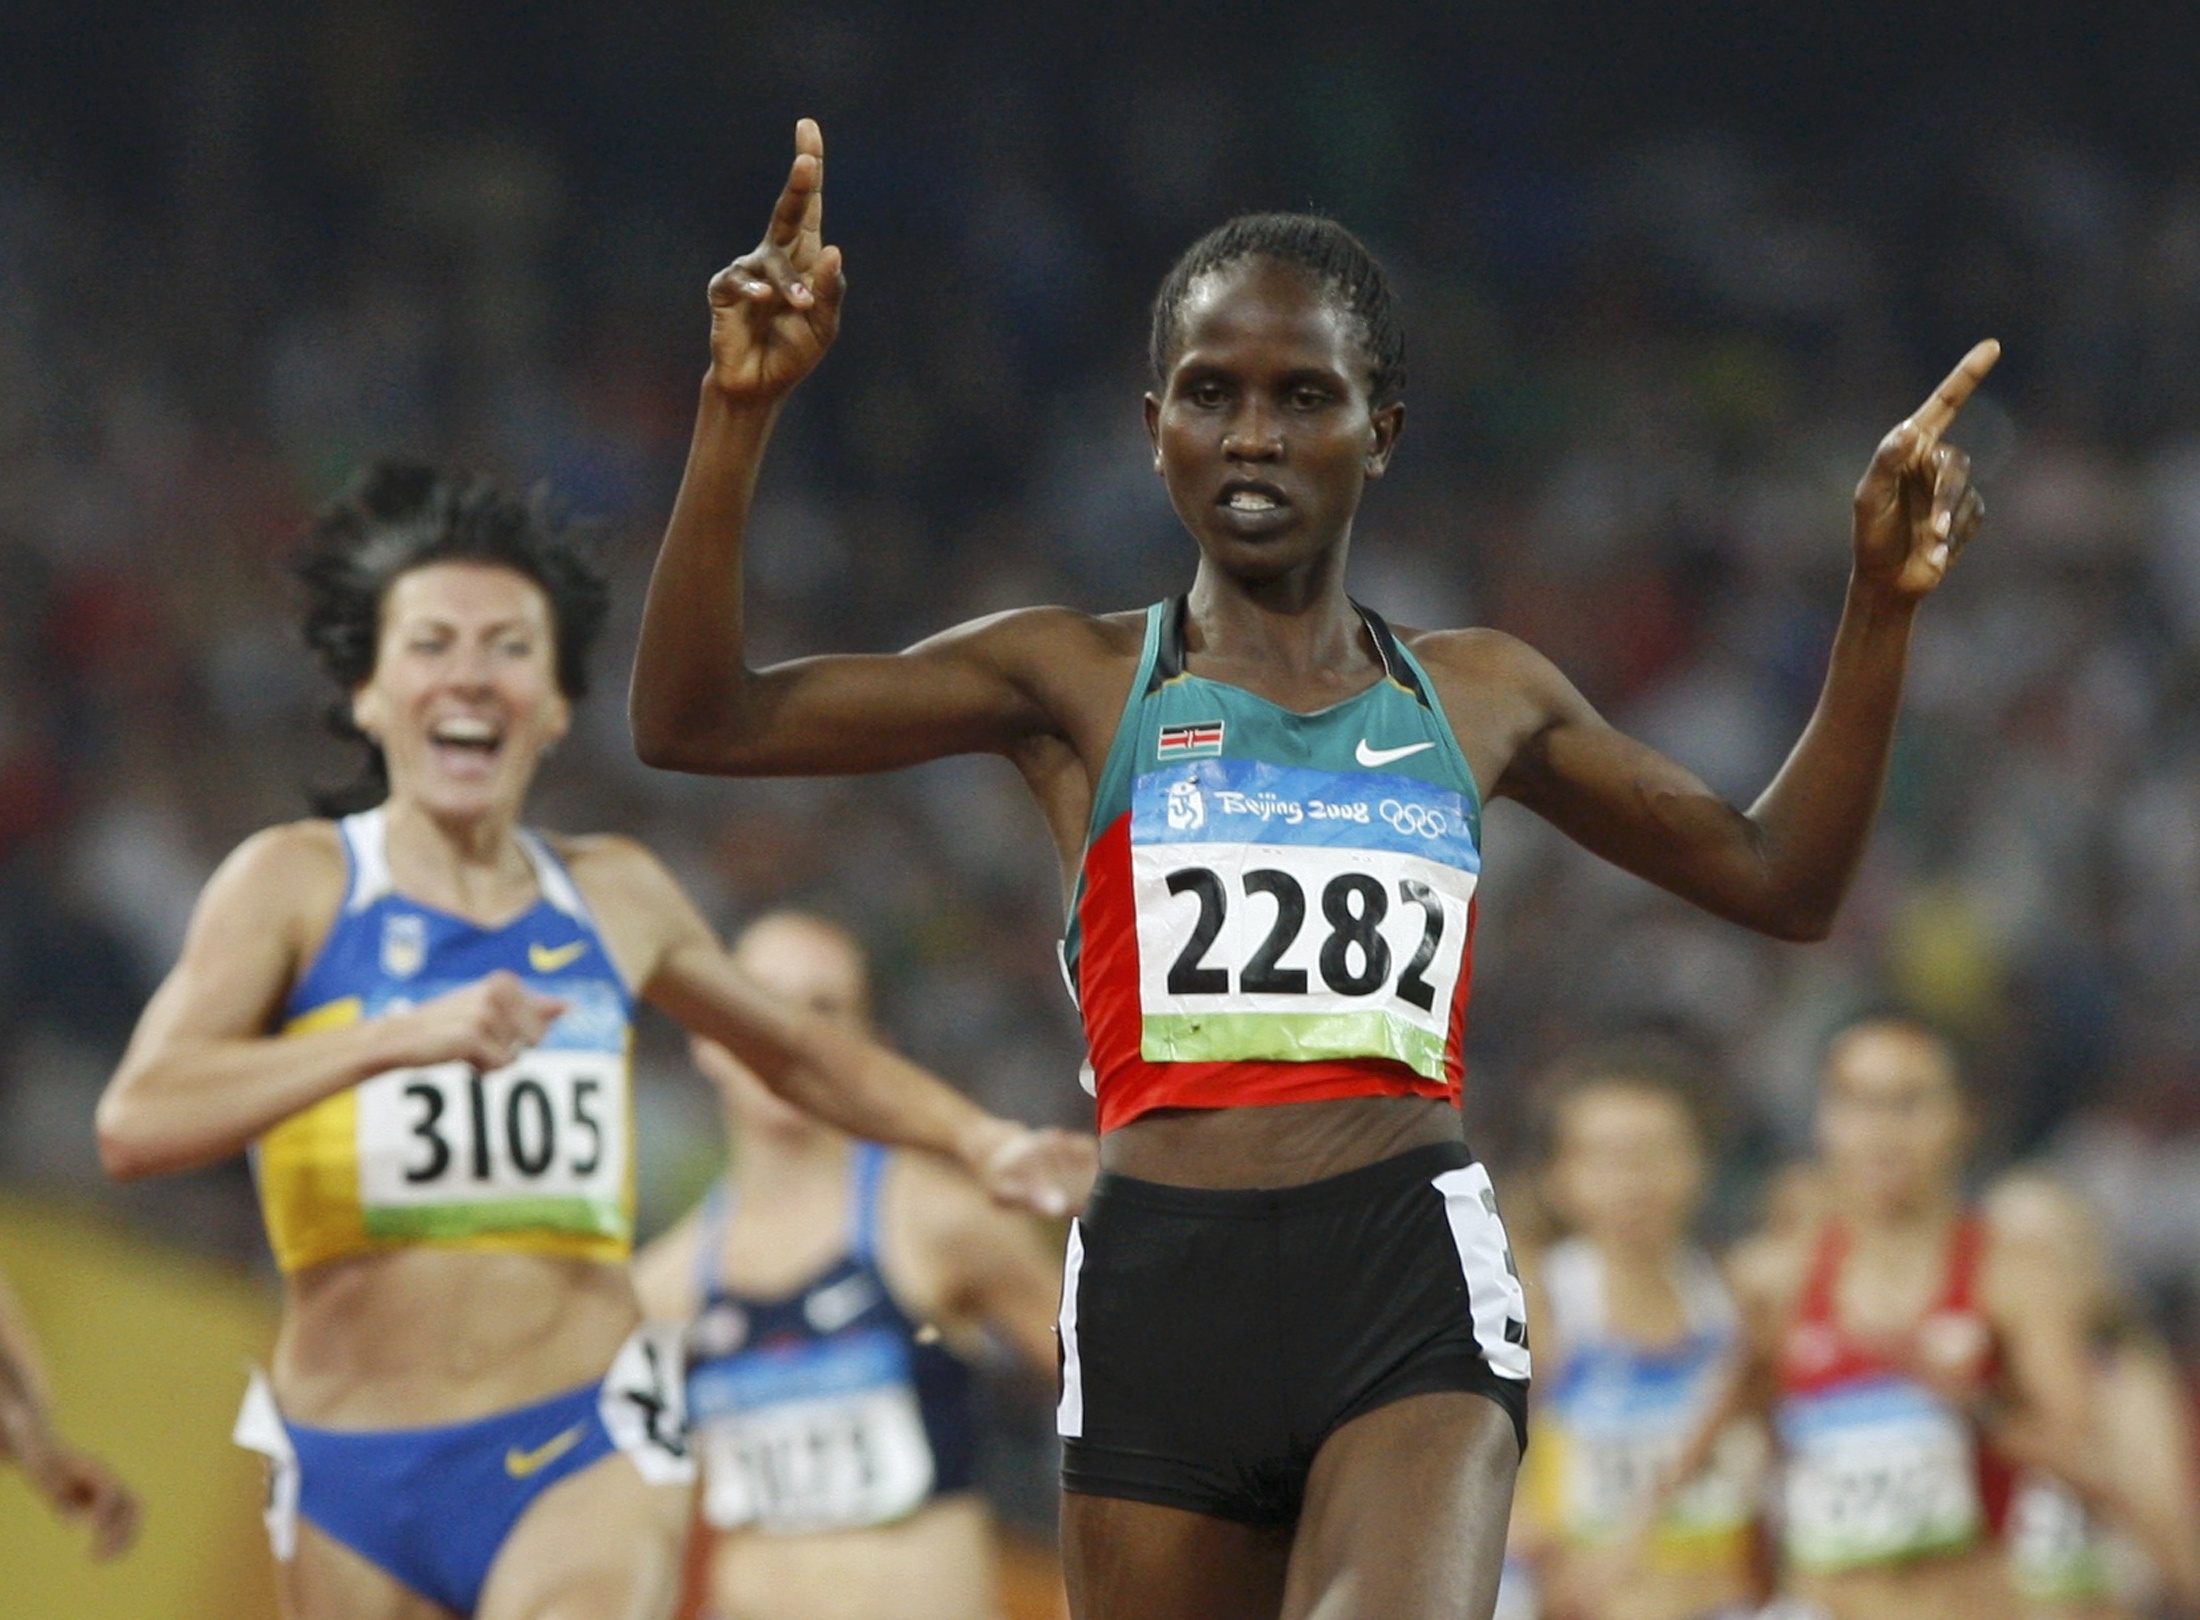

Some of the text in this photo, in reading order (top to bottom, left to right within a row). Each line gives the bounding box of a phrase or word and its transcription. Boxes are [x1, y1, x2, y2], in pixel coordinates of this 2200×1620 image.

[1213, 791, 1370, 824] Beijing 2008
[1165, 866, 1445, 1012] 2282
[403, 1070, 602, 1184] 3105
